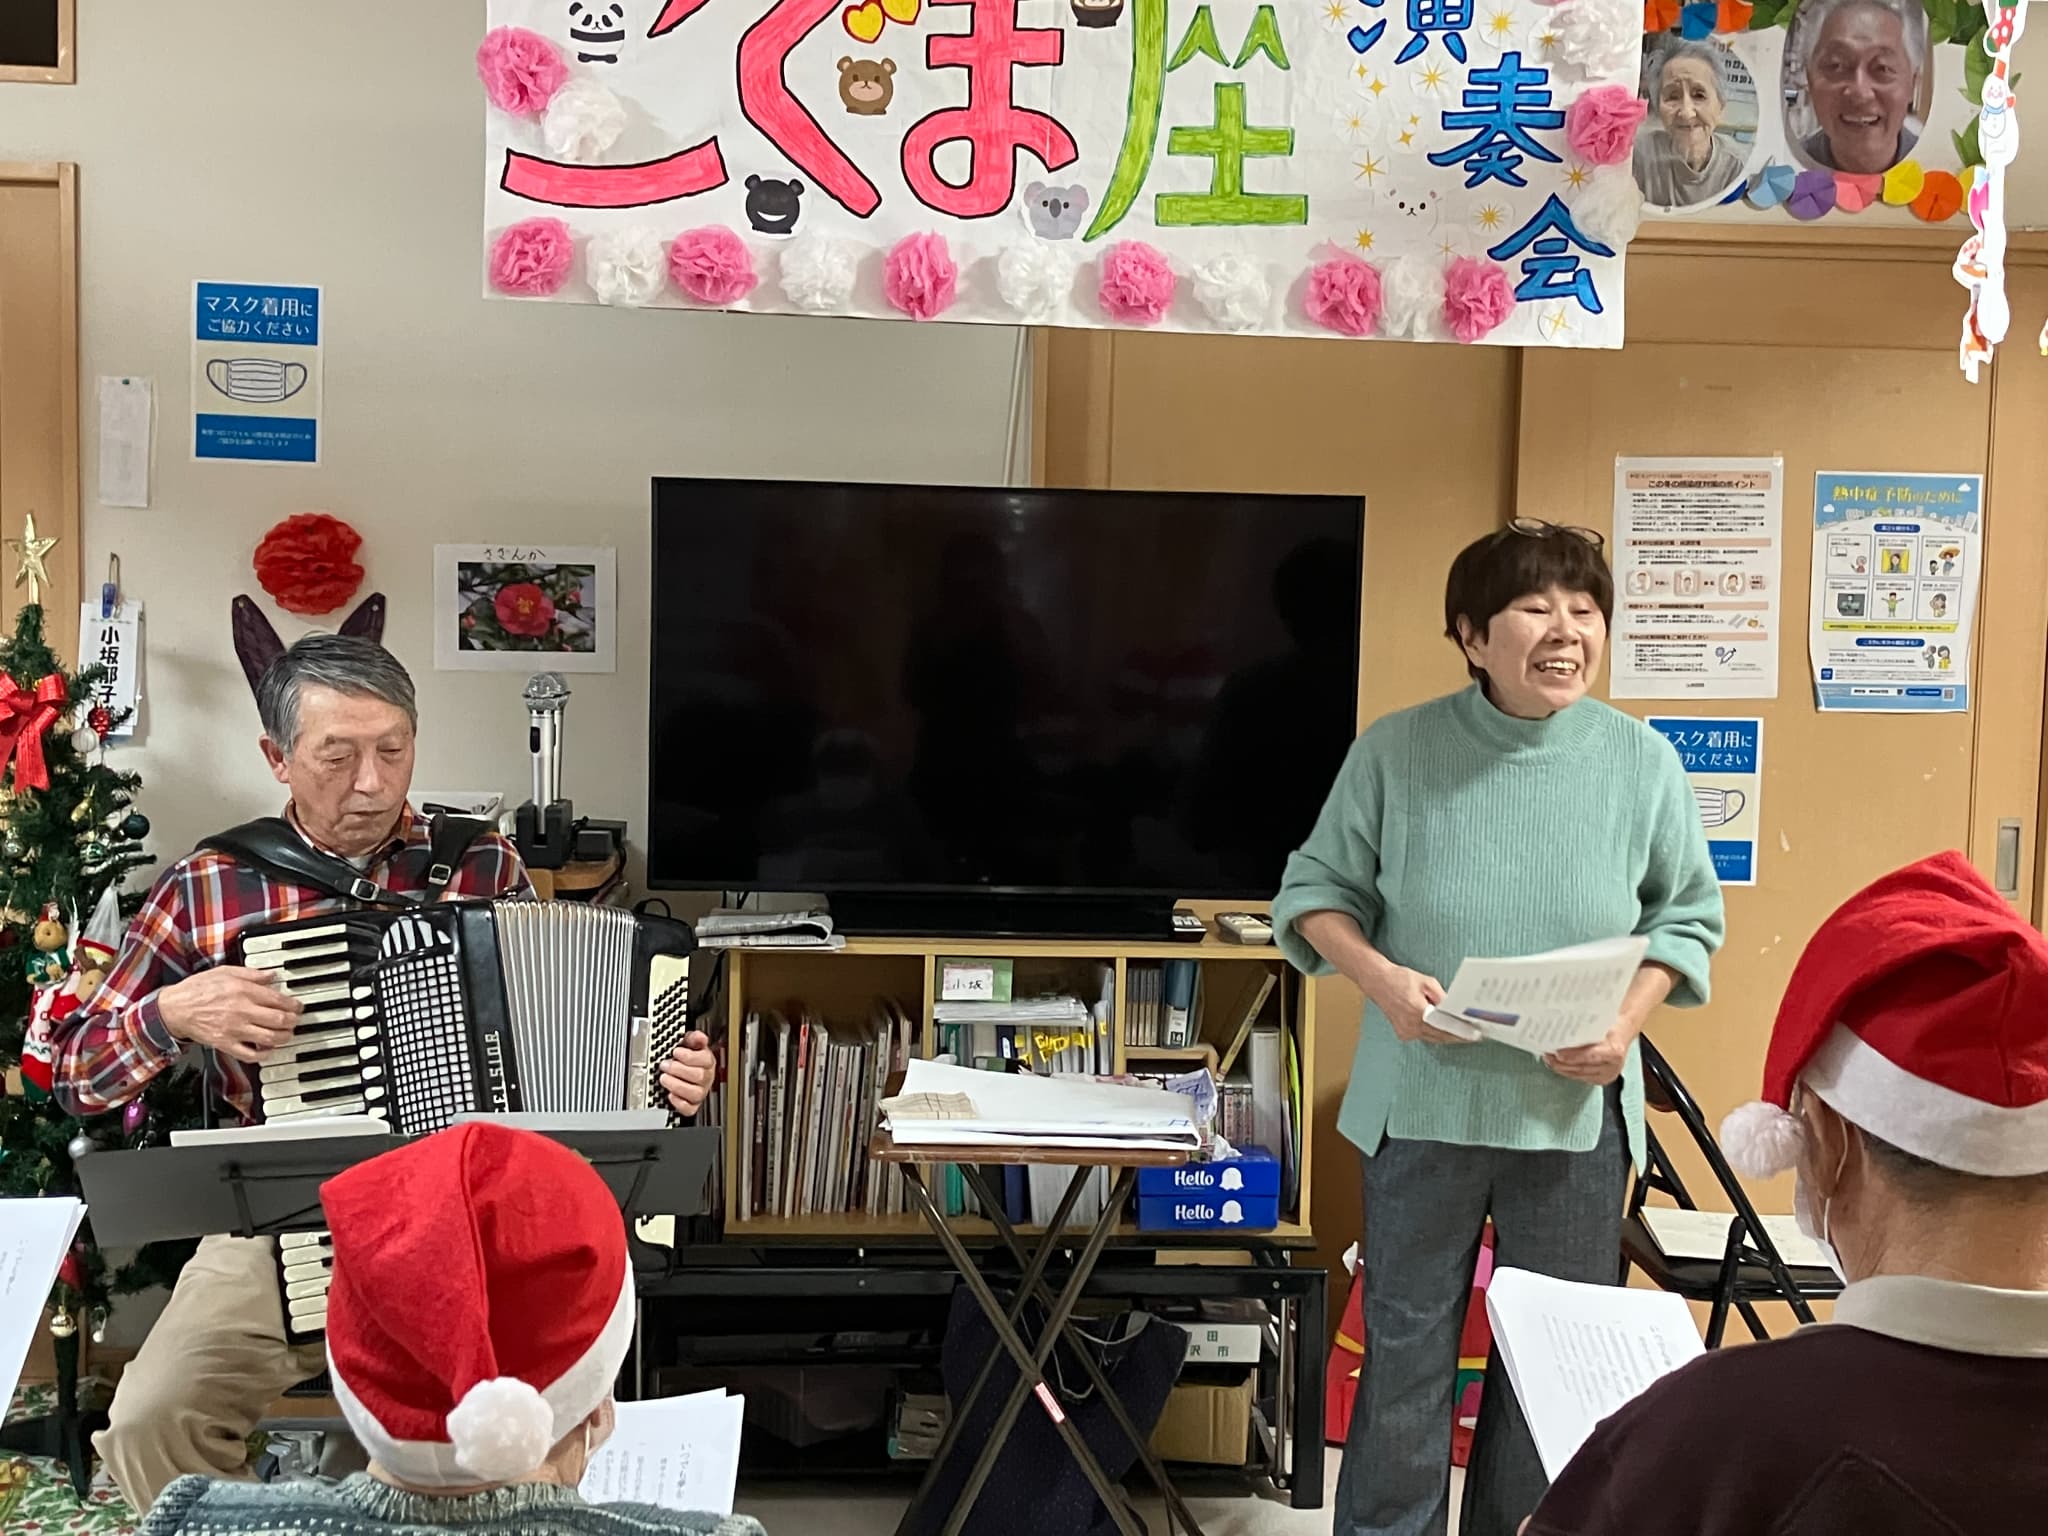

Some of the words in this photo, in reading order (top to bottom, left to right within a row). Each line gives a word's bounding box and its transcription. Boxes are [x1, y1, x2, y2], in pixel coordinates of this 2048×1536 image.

[204, 296, 313, 318] マスク着用に
[207, 318, 310, 337] ご協力ください
[1680, 752, 1749, 766] 力ください
[1174, 1170, 1215, 1186] Hello
[1175, 1204, 1215, 1220] Hello
